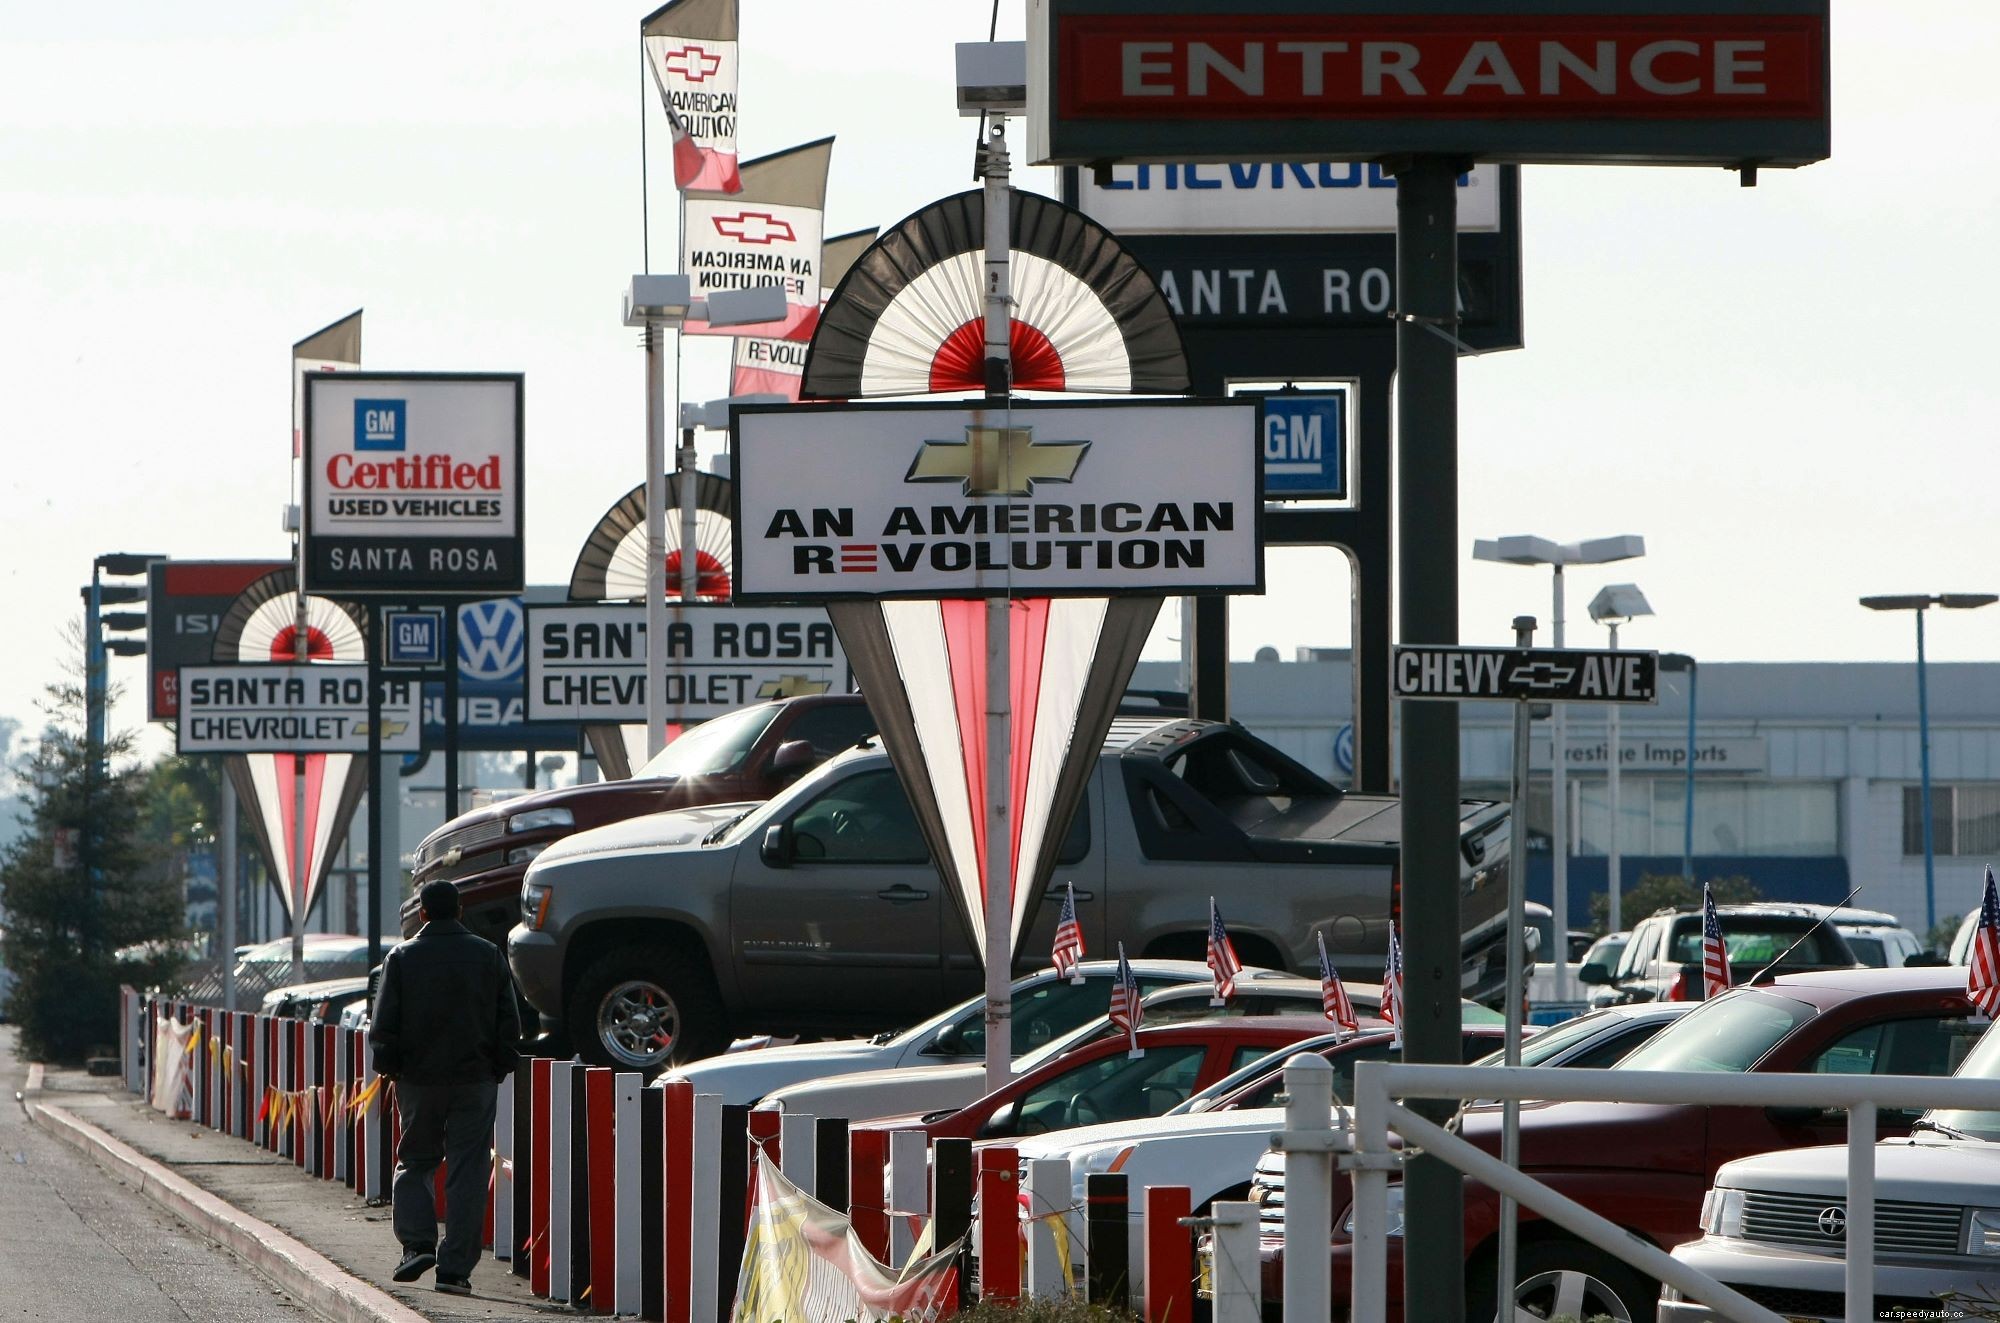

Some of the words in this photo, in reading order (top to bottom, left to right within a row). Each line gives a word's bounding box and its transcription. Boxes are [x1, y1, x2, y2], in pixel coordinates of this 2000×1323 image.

[1121, 39, 1767, 96] ENTRANCE
[671, 91, 736, 113] AMERICAN
[1160, 269, 1288, 315] ANTA
[365, 410, 396, 433] GM
[1264, 414, 1322, 460] GM
[326, 453, 502, 490] Certified
[329, 499, 388, 516] USED
[393, 499, 502, 517] VEHICLES
[764, 507, 854, 538] AN
[882, 502, 1234, 536] AMERICAN
[330, 548, 414, 571] SANTA
[429, 548, 499, 572] ROSA
[793, 539, 1205, 574] REVOLUTION
[399, 623, 430, 645] GM
[713, 623, 834, 658] ROSA
[1397, 651, 1505, 694] CHEVY
[1579, 656, 1651, 697] AVE.
[190, 679, 304, 704] SANTA
[190, 717, 349, 740] CHEVROLET
[1550, 742, 1636, 764] restie
